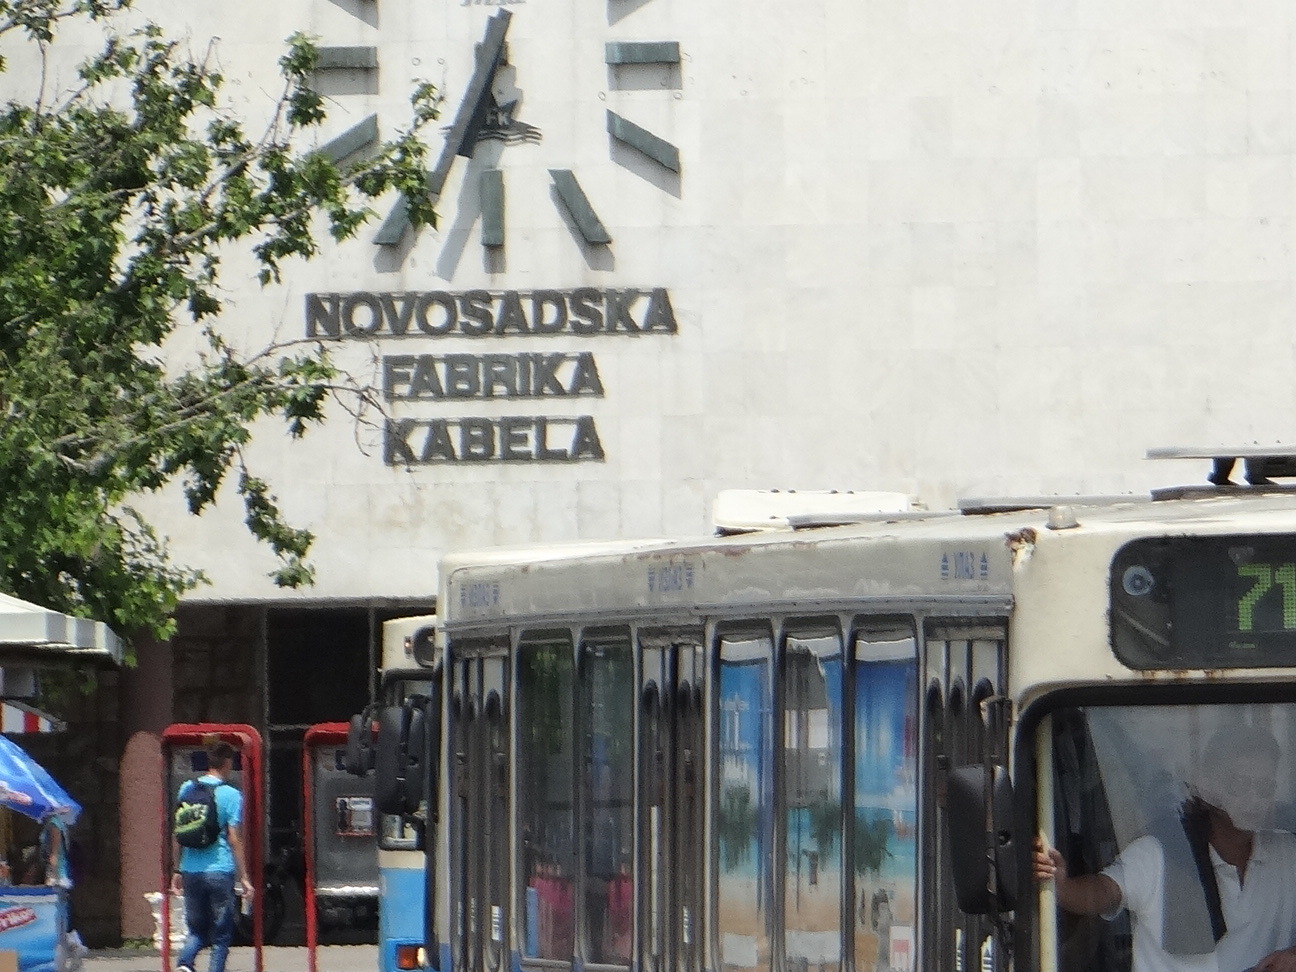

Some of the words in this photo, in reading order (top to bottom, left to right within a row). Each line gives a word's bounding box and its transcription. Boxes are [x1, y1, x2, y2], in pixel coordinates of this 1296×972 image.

[305, 287, 678, 338] NOVOSADSKA
[383, 351, 605, 399] FABRIKA
[383, 415, 605, 466] KABELA
